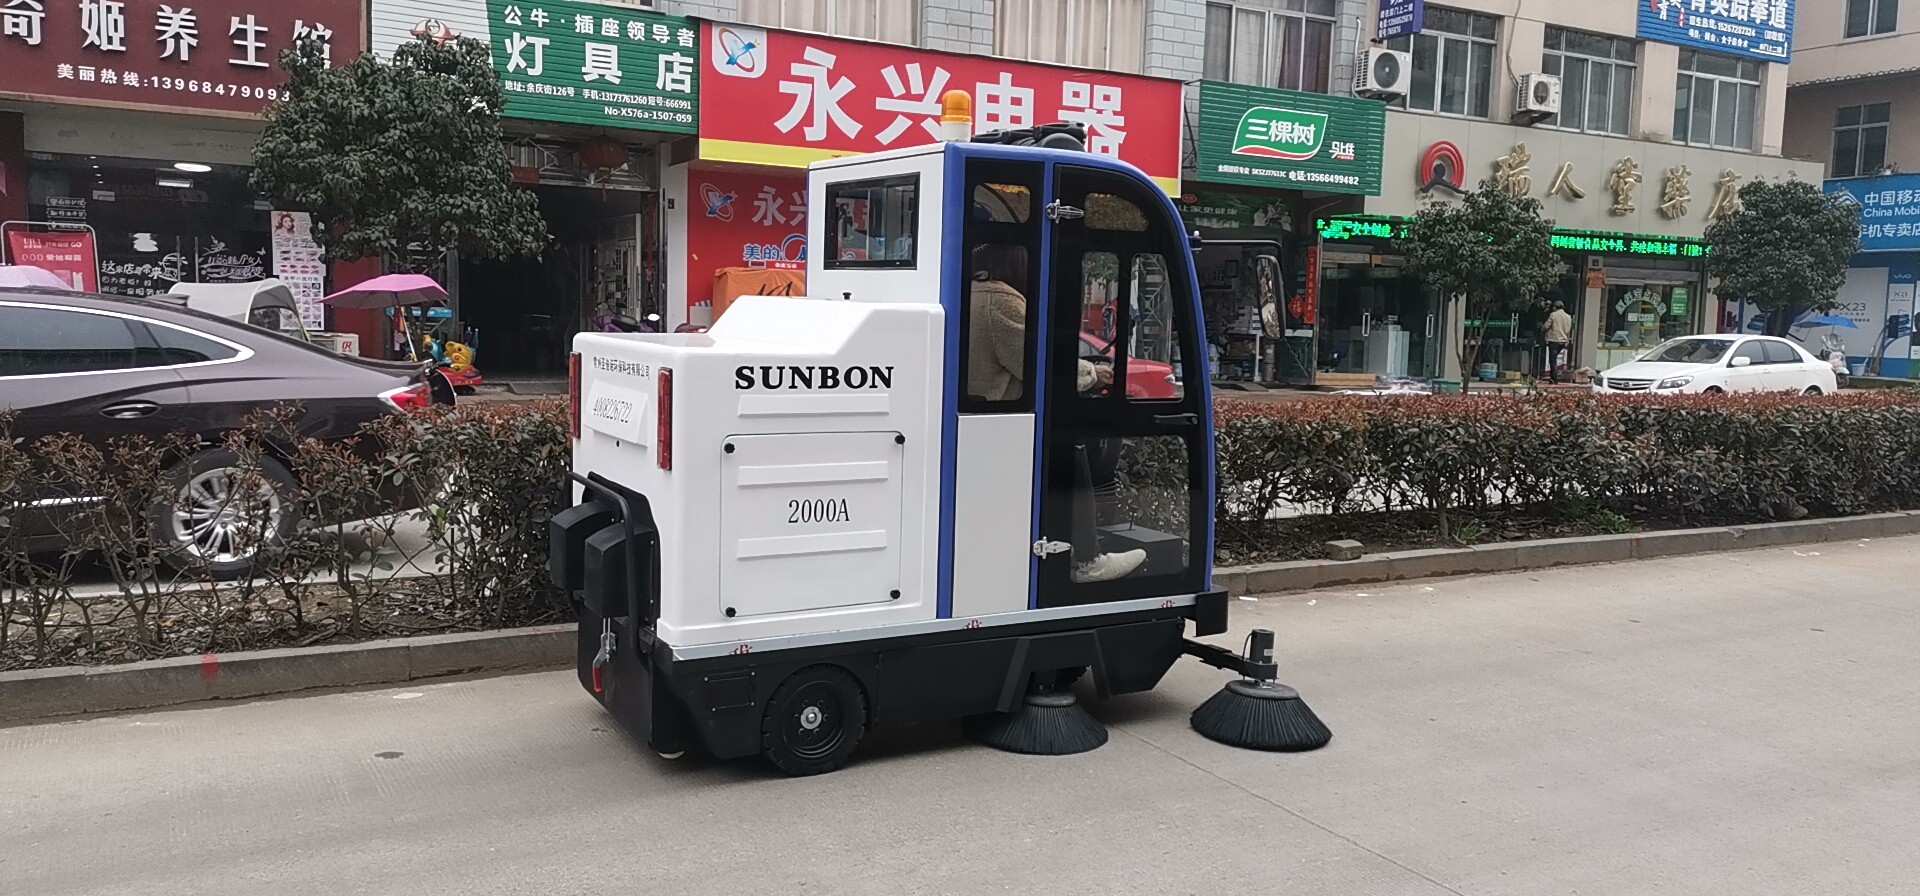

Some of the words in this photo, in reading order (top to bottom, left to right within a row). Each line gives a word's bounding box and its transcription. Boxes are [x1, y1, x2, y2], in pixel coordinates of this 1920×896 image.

[505, 32, 694, 94] 灯具店
[775, 46, 1127, 158] 永兴电器
[1245, 118, 1316, 146] 三棵树
[1863, 207, 1893, 218] China
[743, 243, 782, 262] 美的
[735, 365, 895, 390] SUNBON
[788, 498, 851, 524] 2000A
